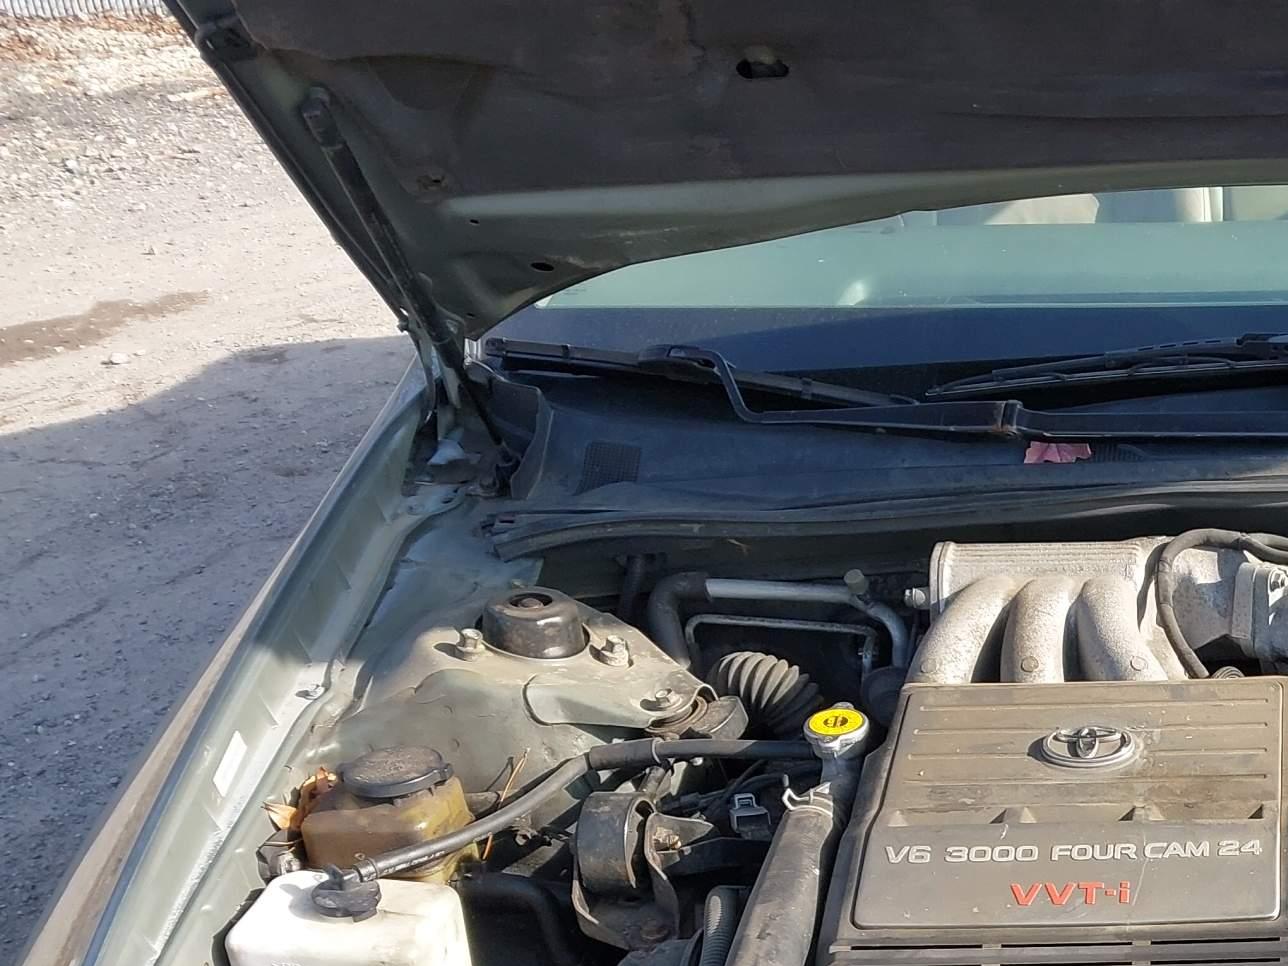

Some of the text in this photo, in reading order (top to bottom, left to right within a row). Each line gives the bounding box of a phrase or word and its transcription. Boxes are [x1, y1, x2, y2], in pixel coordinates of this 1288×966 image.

[886, 838, 1262, 864] V6 3000 FOUR CAM 24
[1010, 880, 1132, 906] VVT-i
